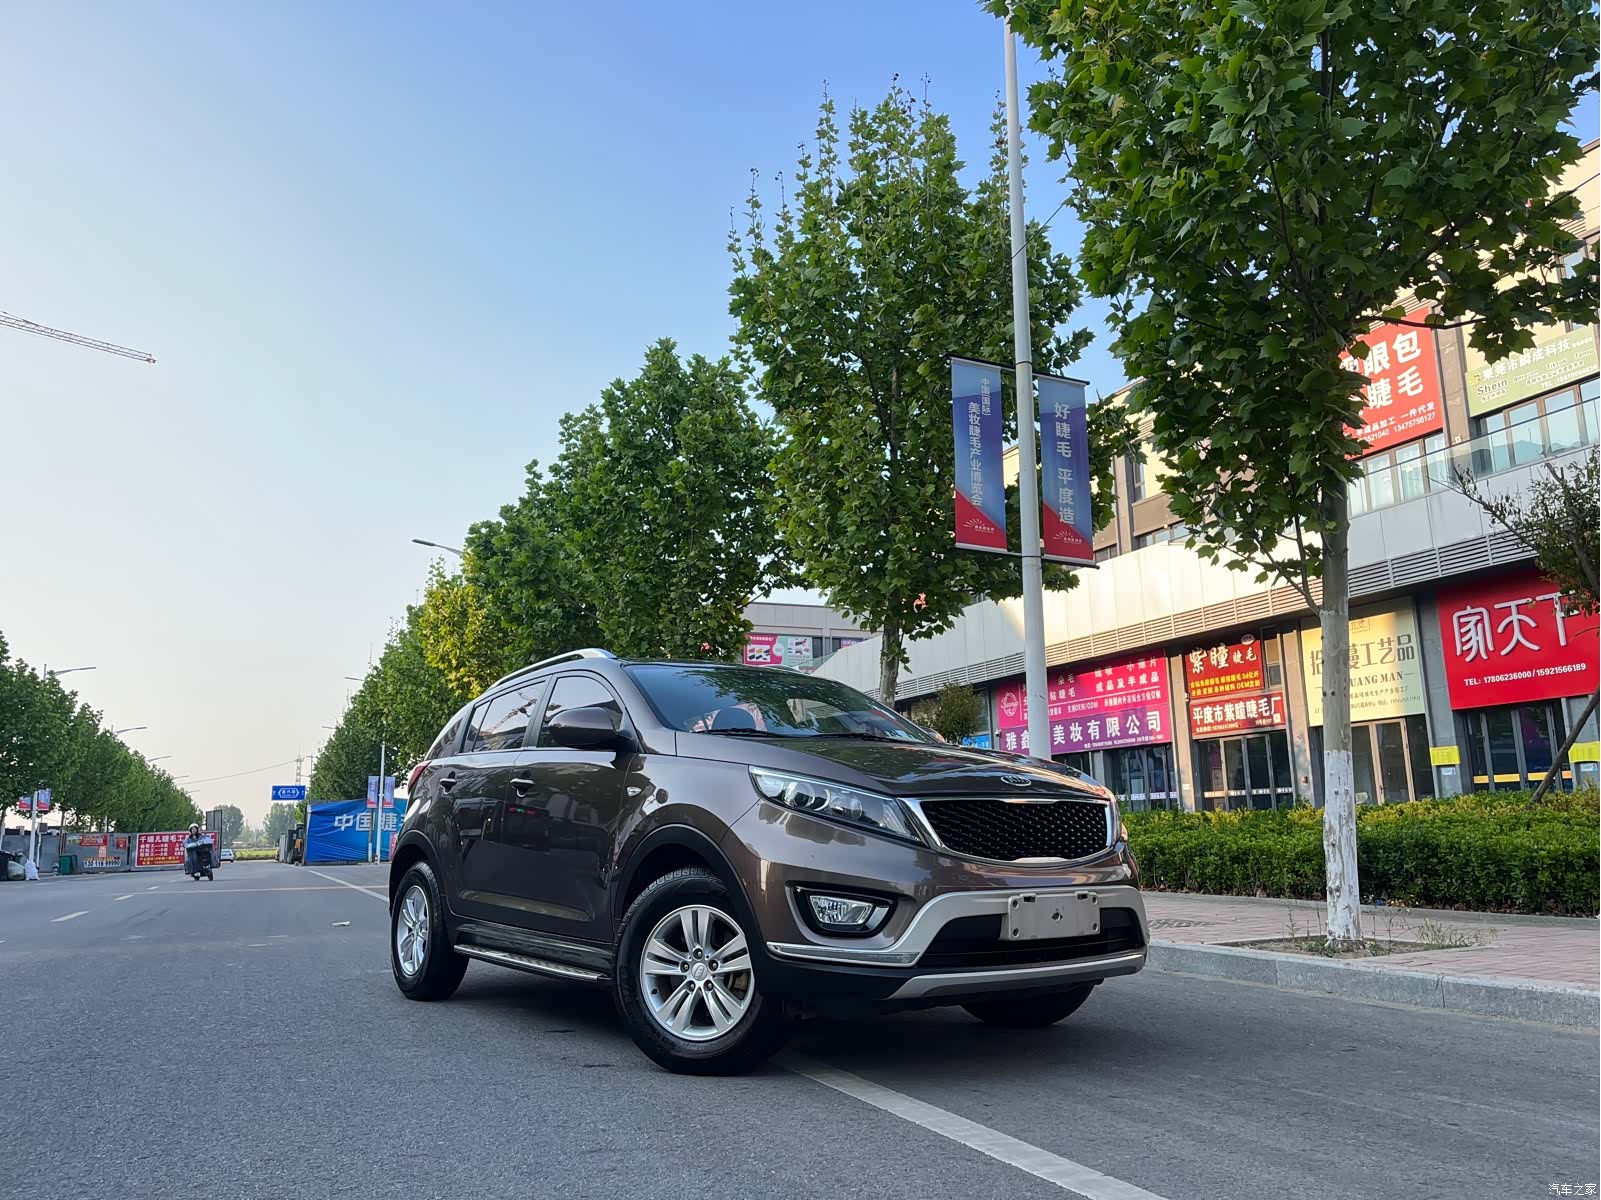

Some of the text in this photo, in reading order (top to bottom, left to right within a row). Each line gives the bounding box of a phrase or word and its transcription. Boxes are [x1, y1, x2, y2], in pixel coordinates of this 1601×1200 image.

[980, 378, 992, 416] 中国国际
[1477, 379, 1508, 396] Shein
[1401, 402, 1435, 420] 一件代发
[1054, 403, 1072, 459] 好睫毛
[967, 402, 983, 507] 美妆睫毛产业博览会
[1057, 468, 1075, 525] 平度造
[1453, 590, 1580, 662] 家天下
[1095, 671, 1160, 692] 成品及半成品
[1349, 671, 1404, 688] UANG MAN
[1464, 678, 1482, 687] TEL:
[1193, 696, 1281, 725] 平度市紫瞳睫毛厂
[1005, 710, 1161, 750] 雅鑫美妆有限公司
